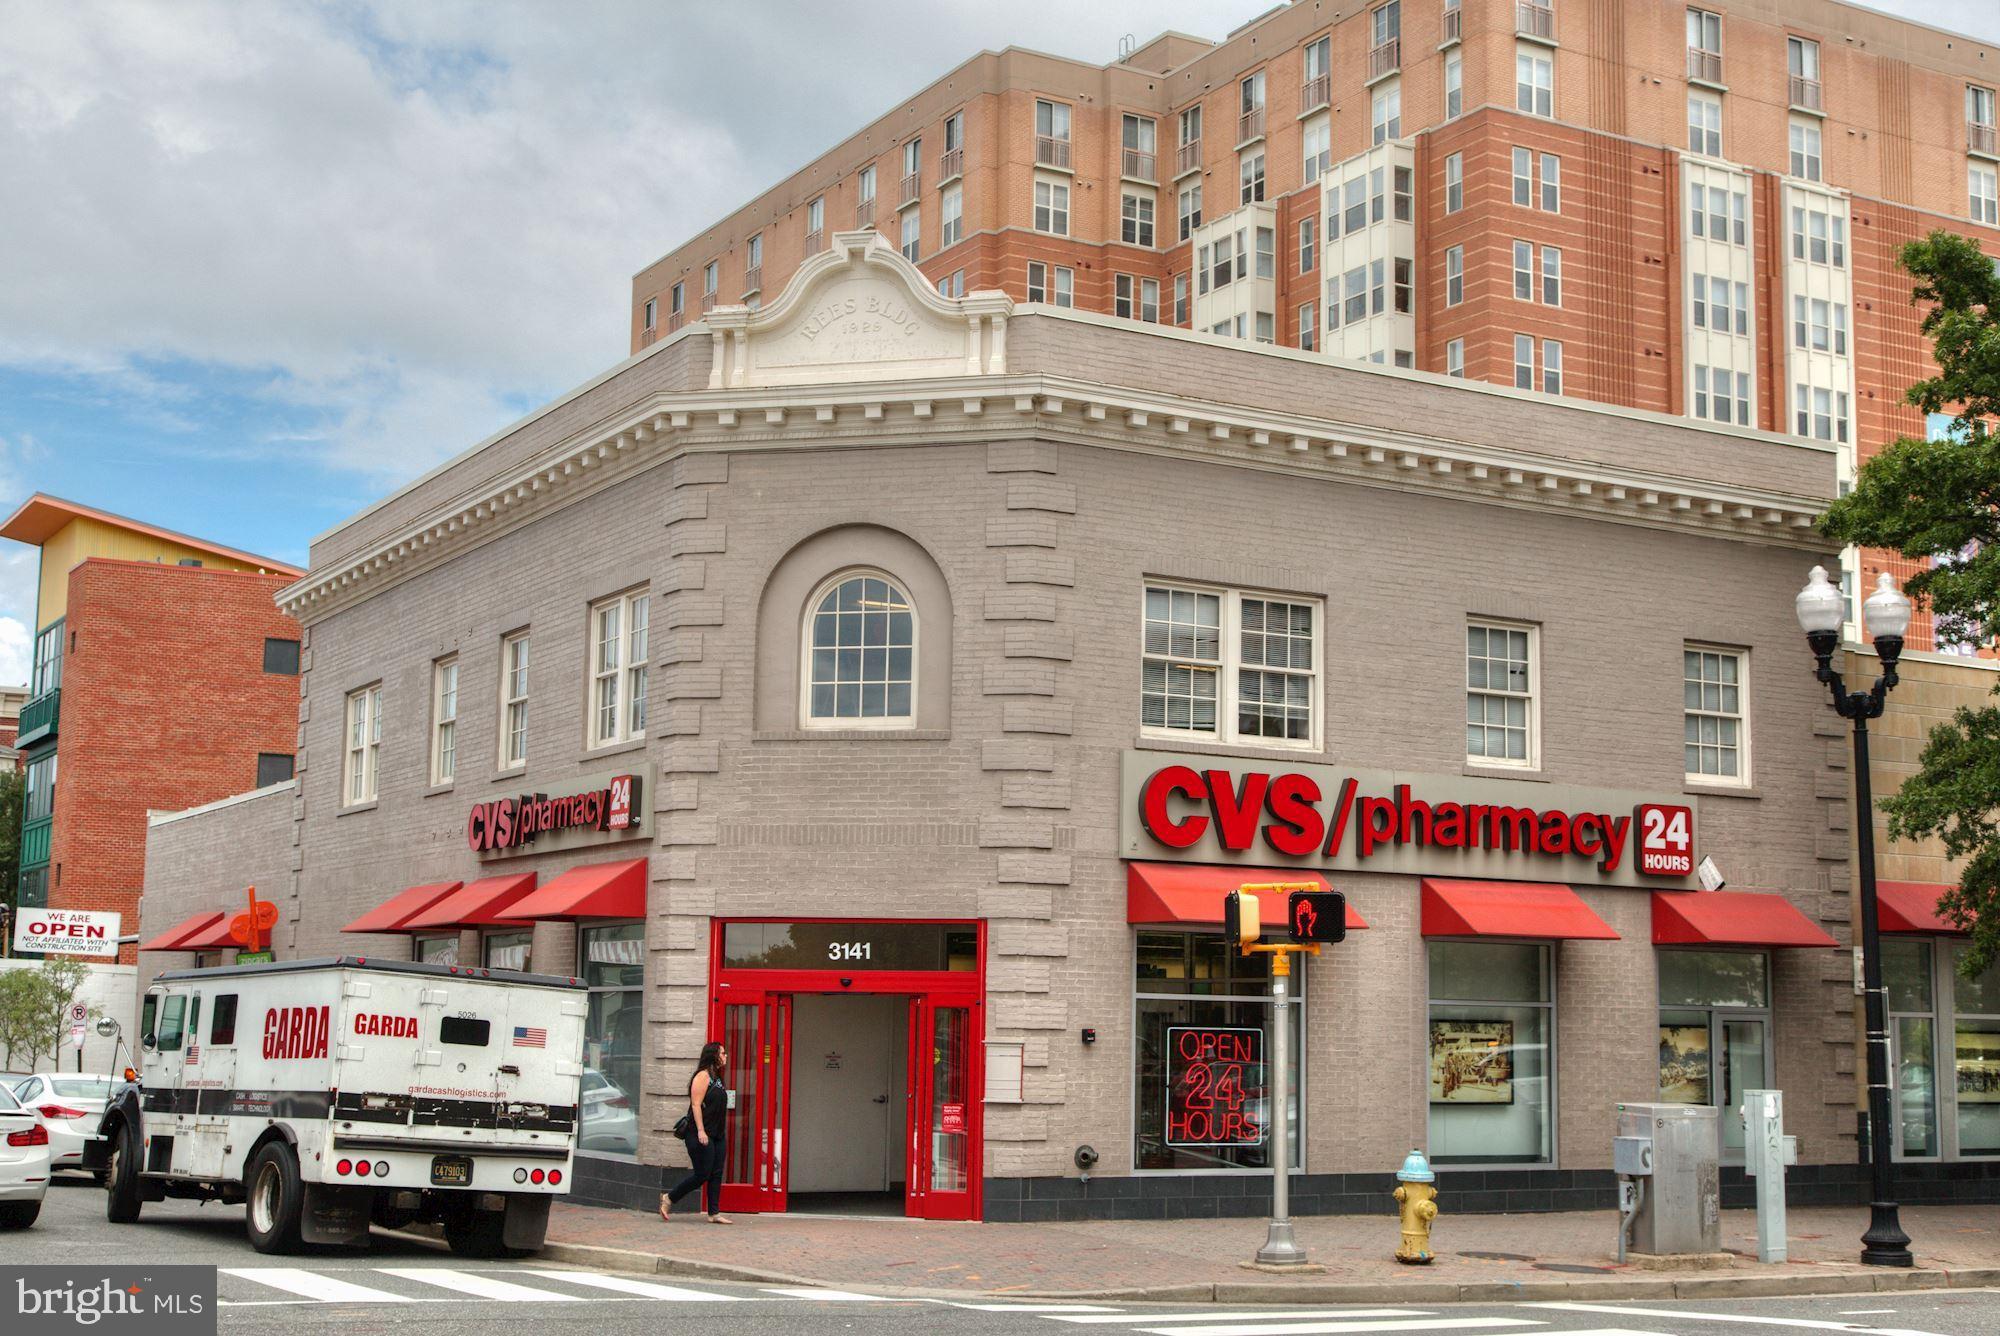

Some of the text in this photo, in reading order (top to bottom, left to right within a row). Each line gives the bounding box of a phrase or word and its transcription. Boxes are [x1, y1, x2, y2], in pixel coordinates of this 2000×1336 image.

[801, 298, 857, 341] REES
[611, 779, 631, 811] 24
[610, 812, 630, 826] HOURS
[1138, 765, 1631, 872] CVS/pharmacy
[1644, 809, 1690, 850] 24
[1644, 854, 1690, 871] HOURS
[47, 912, 91, 923] WE ARE
[28, 922, 105, 938] OPEN
[42, 936, 84, 945] AFFILIATED
[87, 938, 109, 946] WITH
[25, 941, 86, 951] CONSTRUCTION
[828, 942, 871, 960] 3141
[457, 1010, 477, 1019] 5026
[262, 1005, 330, 1060] GARDA
[354, 1013, 418, 1039] GARDA
[1179, 1031, 1252, 1062] OPEN
[408, 1085, 507, 1099] gardacashlogistics.com
[1185, 1062, 1246, 1111] 24
[1168, 1111, 1259, 1141] HOURS
